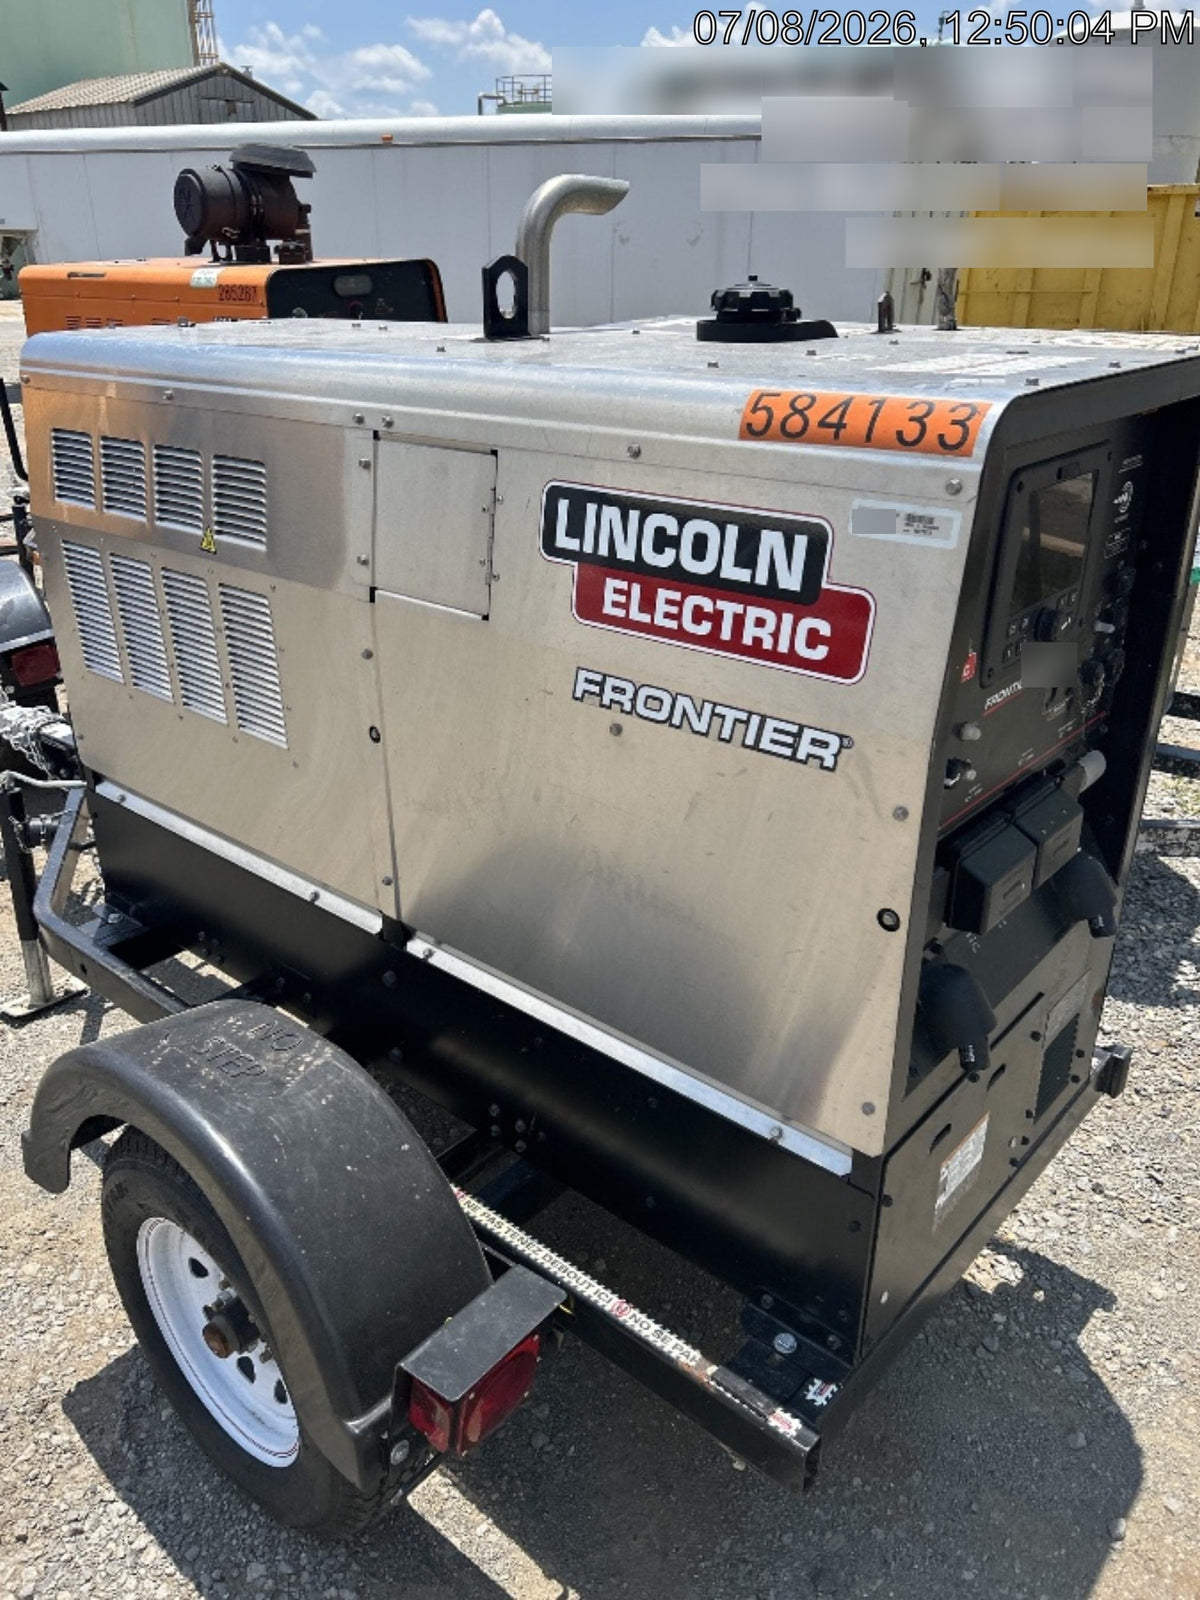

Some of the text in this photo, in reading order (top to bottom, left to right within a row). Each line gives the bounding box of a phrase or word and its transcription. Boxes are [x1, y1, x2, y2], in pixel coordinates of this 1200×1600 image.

[746, 392, 979, 451] 584133
[555, 498, 808, 592] LINCOLN
[602, 577, 832, 661] ELECTRIC
[463, 1200, 481, 1214] NE
[481, 1211, 504, 1230] PAS
[504, 1225, 543, 1255] TENEZ
[542, 1253, 594, 1290] DEBOUT
[629, 1313, 651, 1331] NO
[651, 1329, 672, 1346] SE
